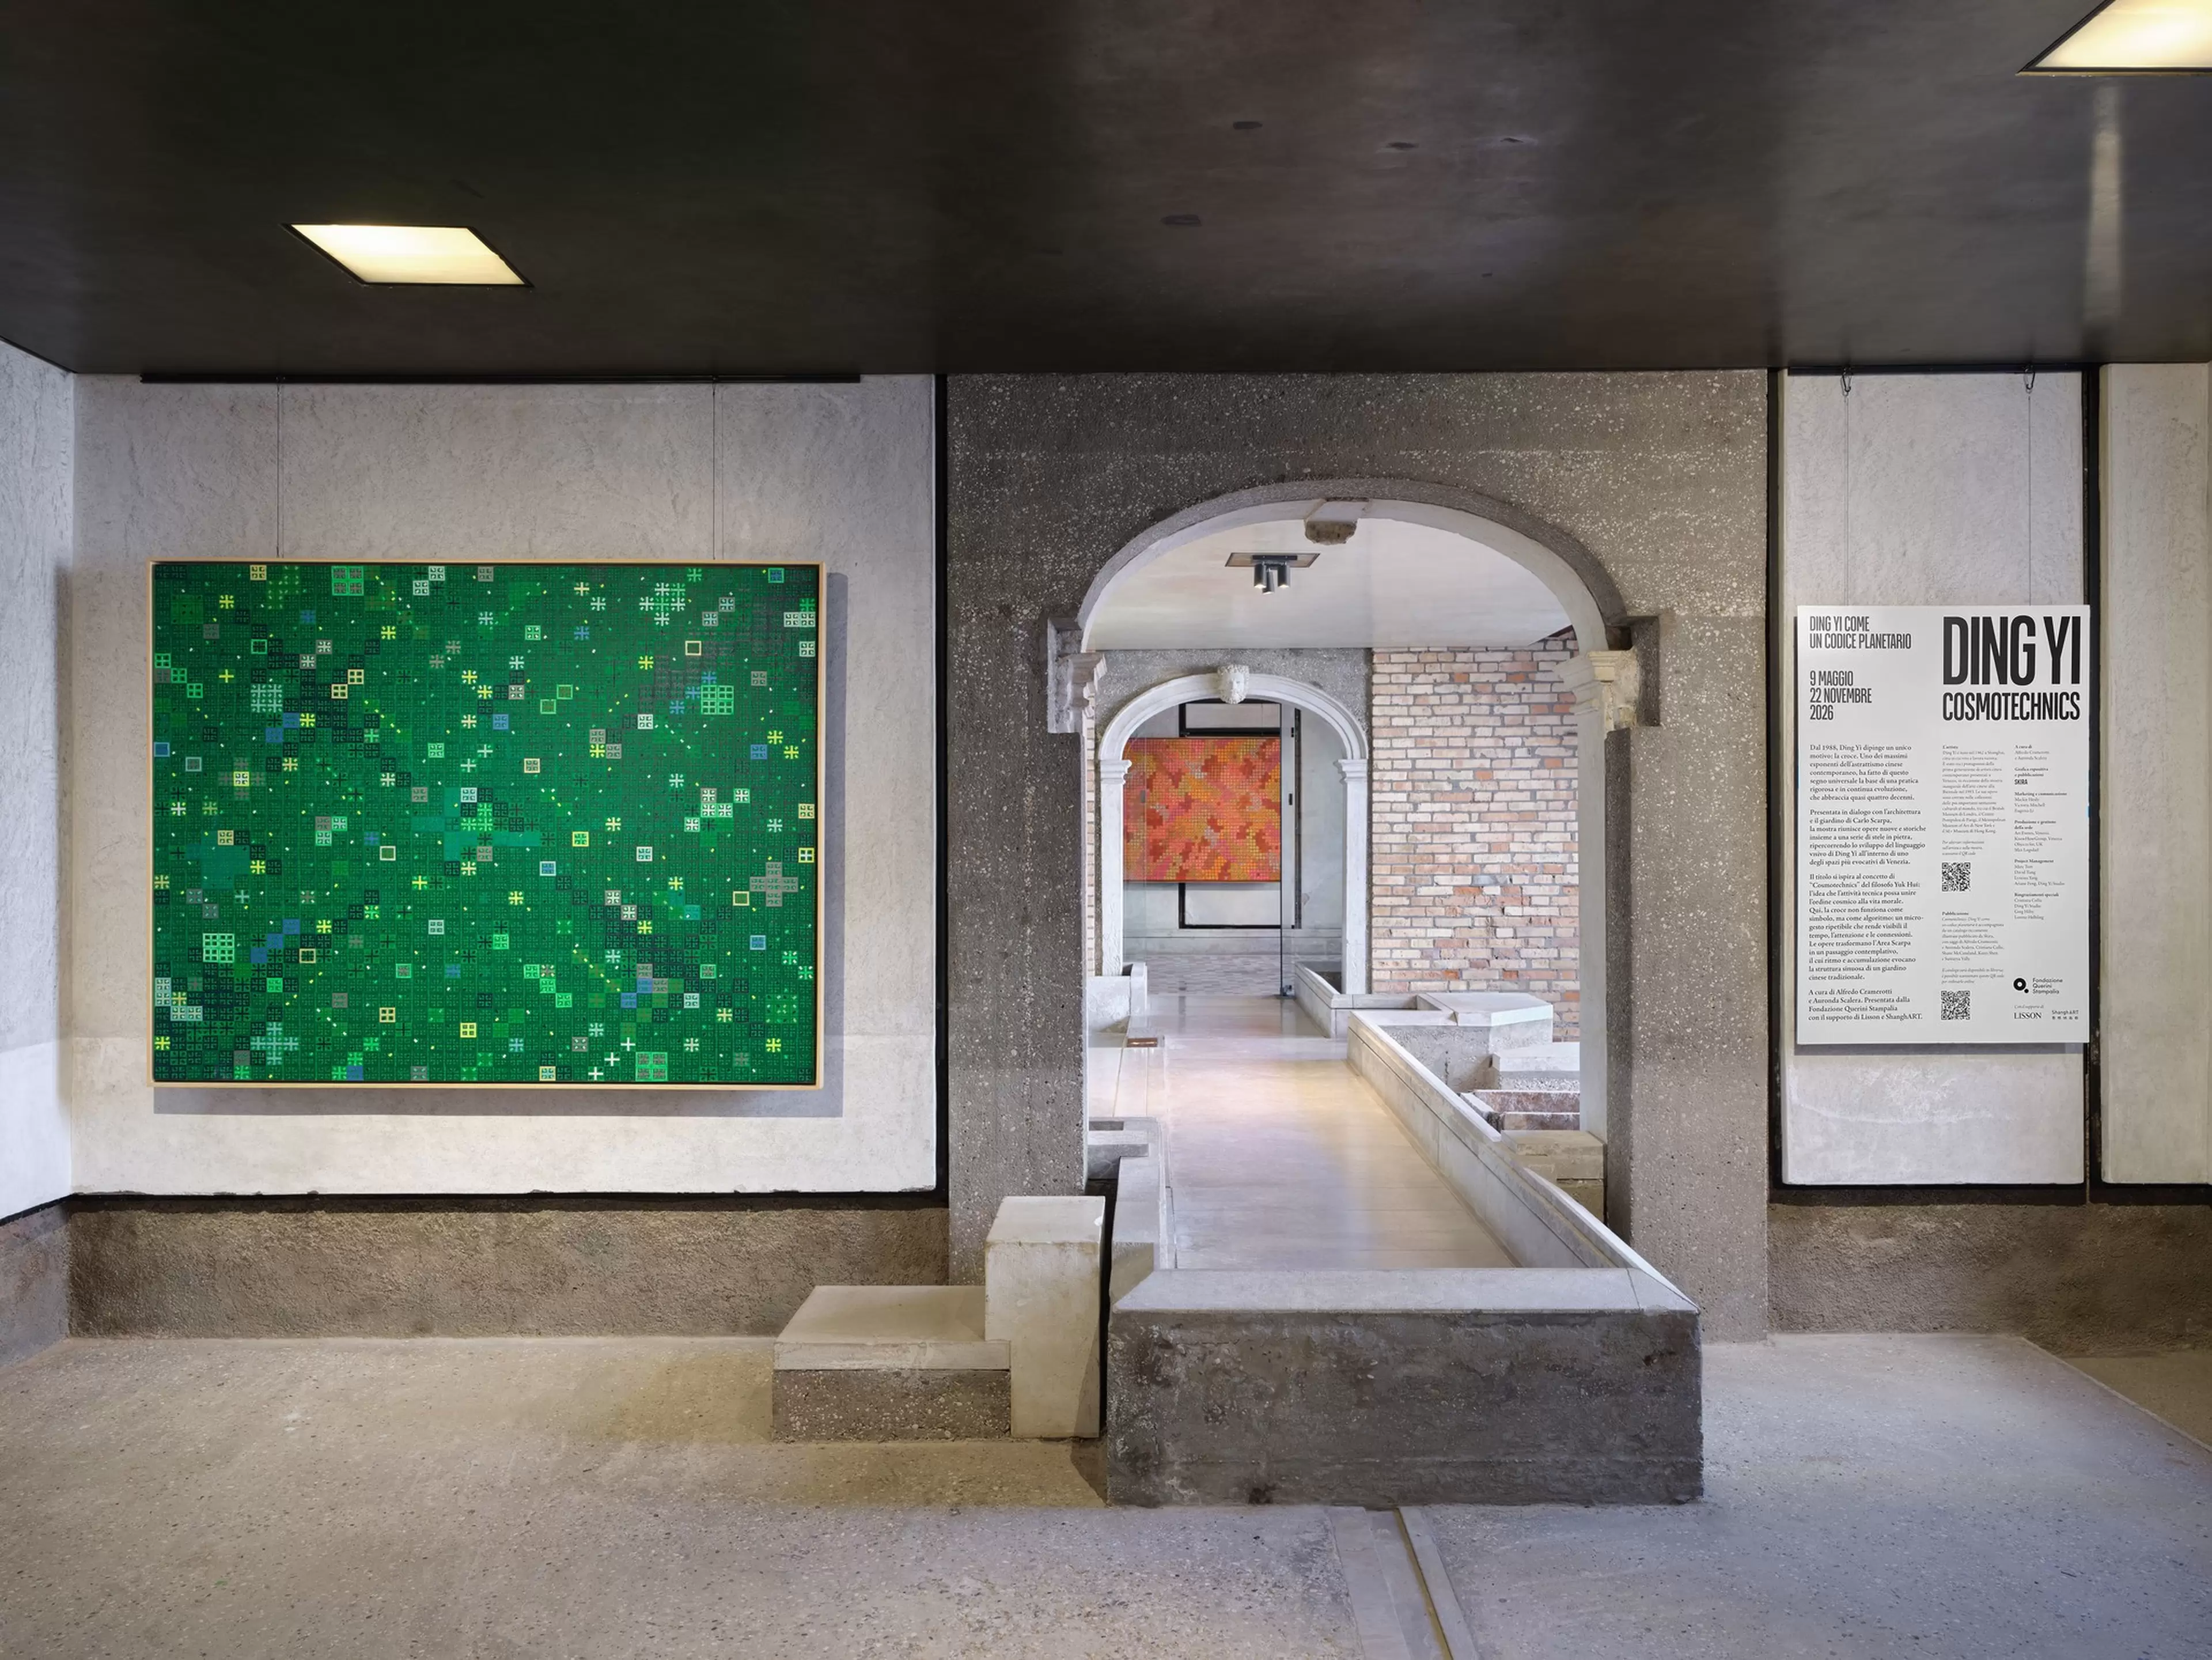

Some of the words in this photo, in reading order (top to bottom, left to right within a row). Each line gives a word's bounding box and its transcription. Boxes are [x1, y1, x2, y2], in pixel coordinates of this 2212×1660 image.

[1810, 617, 1831, 631] DING
[1834, 617, 1842, 631] YI
[1845, 616, 1869, 632] COME
[1810, 634, 1821, 648] UN
[1825, 633, 1856, 648] CODICE
[1859, 633, 1911, 649] PLANETARIO
[1943, 615, 2036, 686] DING
[2043, 616, 2081, 685] YI
[1810, 671, 1816, 686] 9
[1819, 671, 1853, 686] MAGGIO
[1810, 687, 1821, 702] 22
[1824, 687, 1872, 703] NOVEMBRE
[1943, 691, 2080, 721] COSMOTECHNICS
[1810, 705, 1833, 720] 2026
[1823, 744, 1838, 753] 1988,
[1839, 744, 1854, 753] Ding
[1863, 744, 1884, 753] dipinge
[1809, 761, 1838, 769] esponenti
[1899, 777, 1919, 786] pratica
[1809, 786, 1834, 794] rigorosa
[1874, 785, 1907, 794] evoluzione,
[1850, 794, 1866, 802] quasi
[1867, 794, 1889, 802] quattro
[1849, 808, 1870, 817] dialogo
[1820, 817, 1844, 825] giardino
[1870, 817, 1892, 825] Scarpa,
[1809, 842, 1851, 850] ripercorrendo
[1859, 842, 1884, 850] sviluppo
[1895, 842, 1925, 850] linguaggio
[1835, 850, 1850, 859] Ding
[1809, 859, 1824, 867] degli
[1839, 873, 1855, 882] ispira
[1809, 907, 1823, 915] Qui,
[1809, 923, 1824, 932] gesto
[1825, 923, 1852, 932] ripetibile
[1891, 939, 1911, 948] Scarpa
[1844, 1005, 1868, 1014] Querini
[1869, 1005, 1897, 1013] Stampalia
[1826, 1014, 1853, 1022] supporto
[1886, 1014, 1923, 1022] ShanghART.
